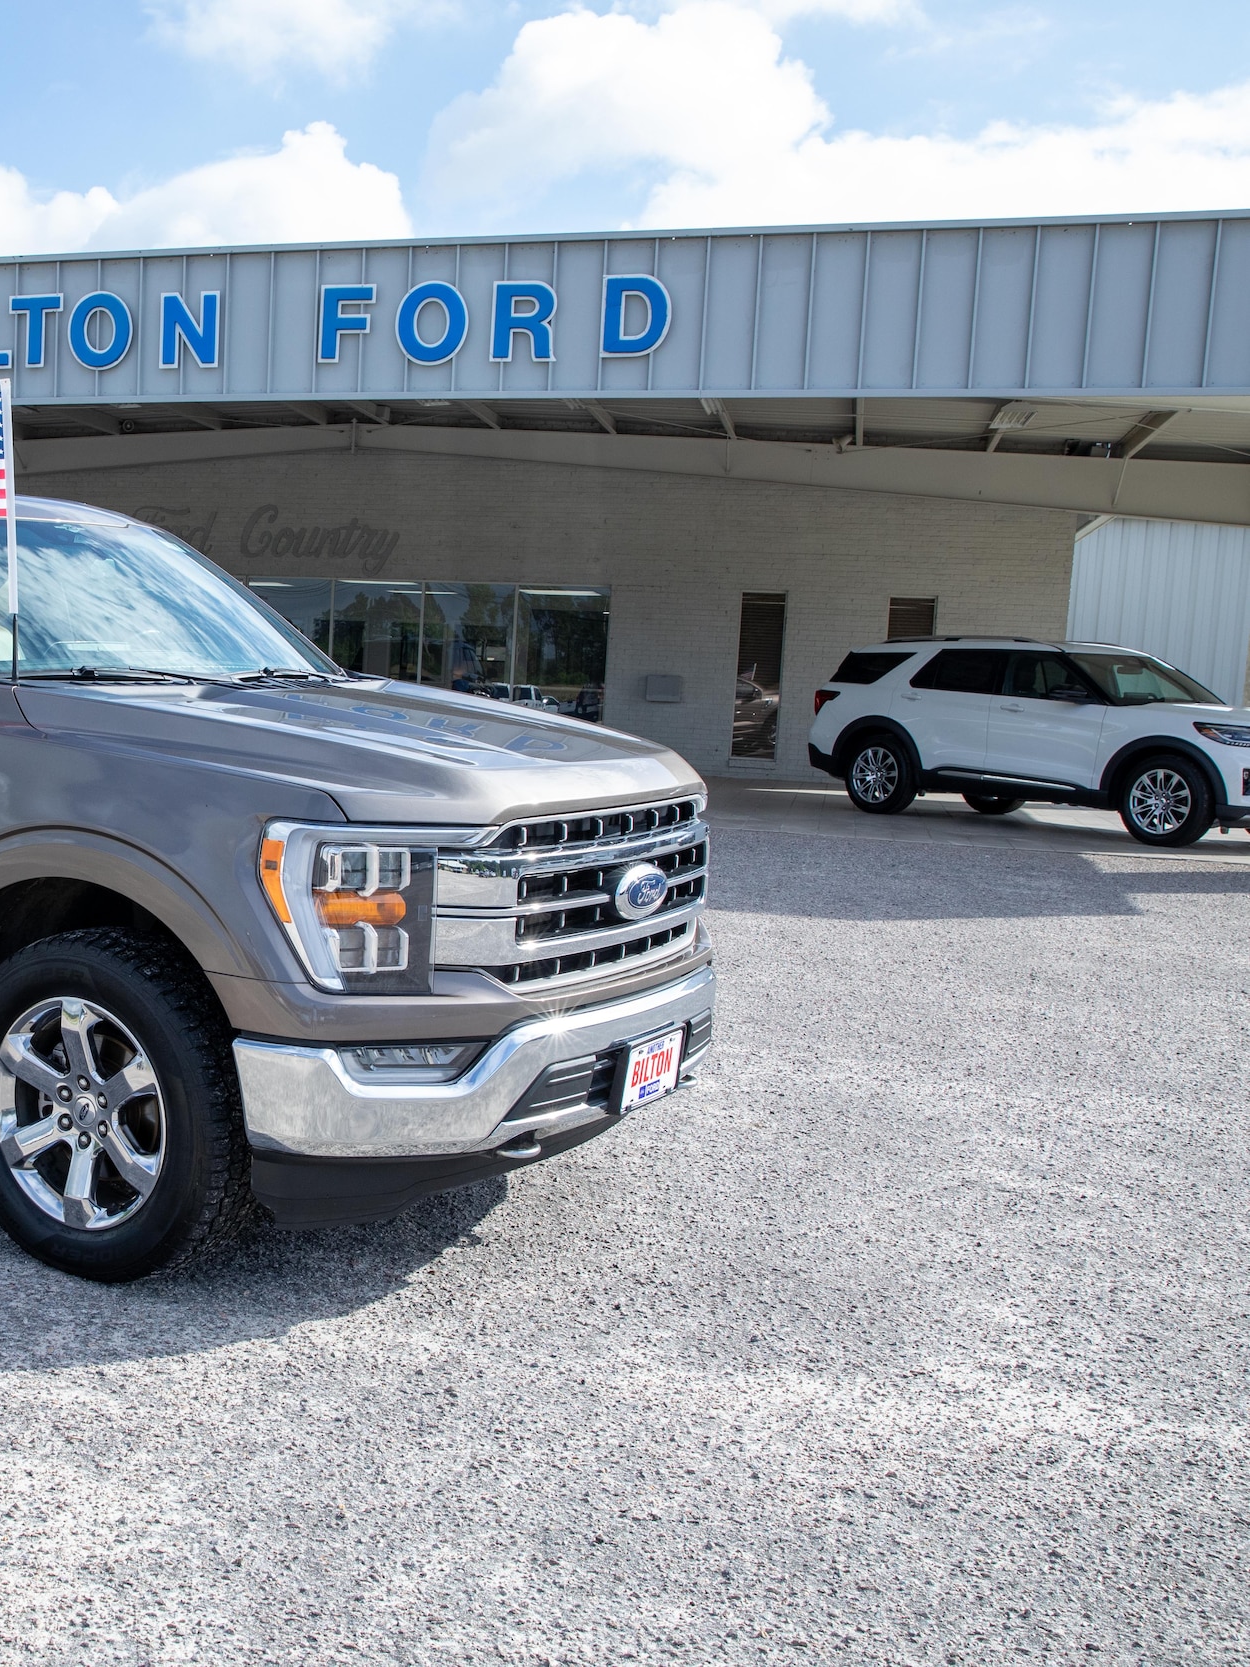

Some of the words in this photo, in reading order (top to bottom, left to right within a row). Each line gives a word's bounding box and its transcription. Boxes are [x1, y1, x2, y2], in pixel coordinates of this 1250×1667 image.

[316, 273, 673, 366] FORD
[240, 503, 400, 576] Country
[637, 879, 662, 905] Ford
[631, 1046, 673, 1088] BILTON
